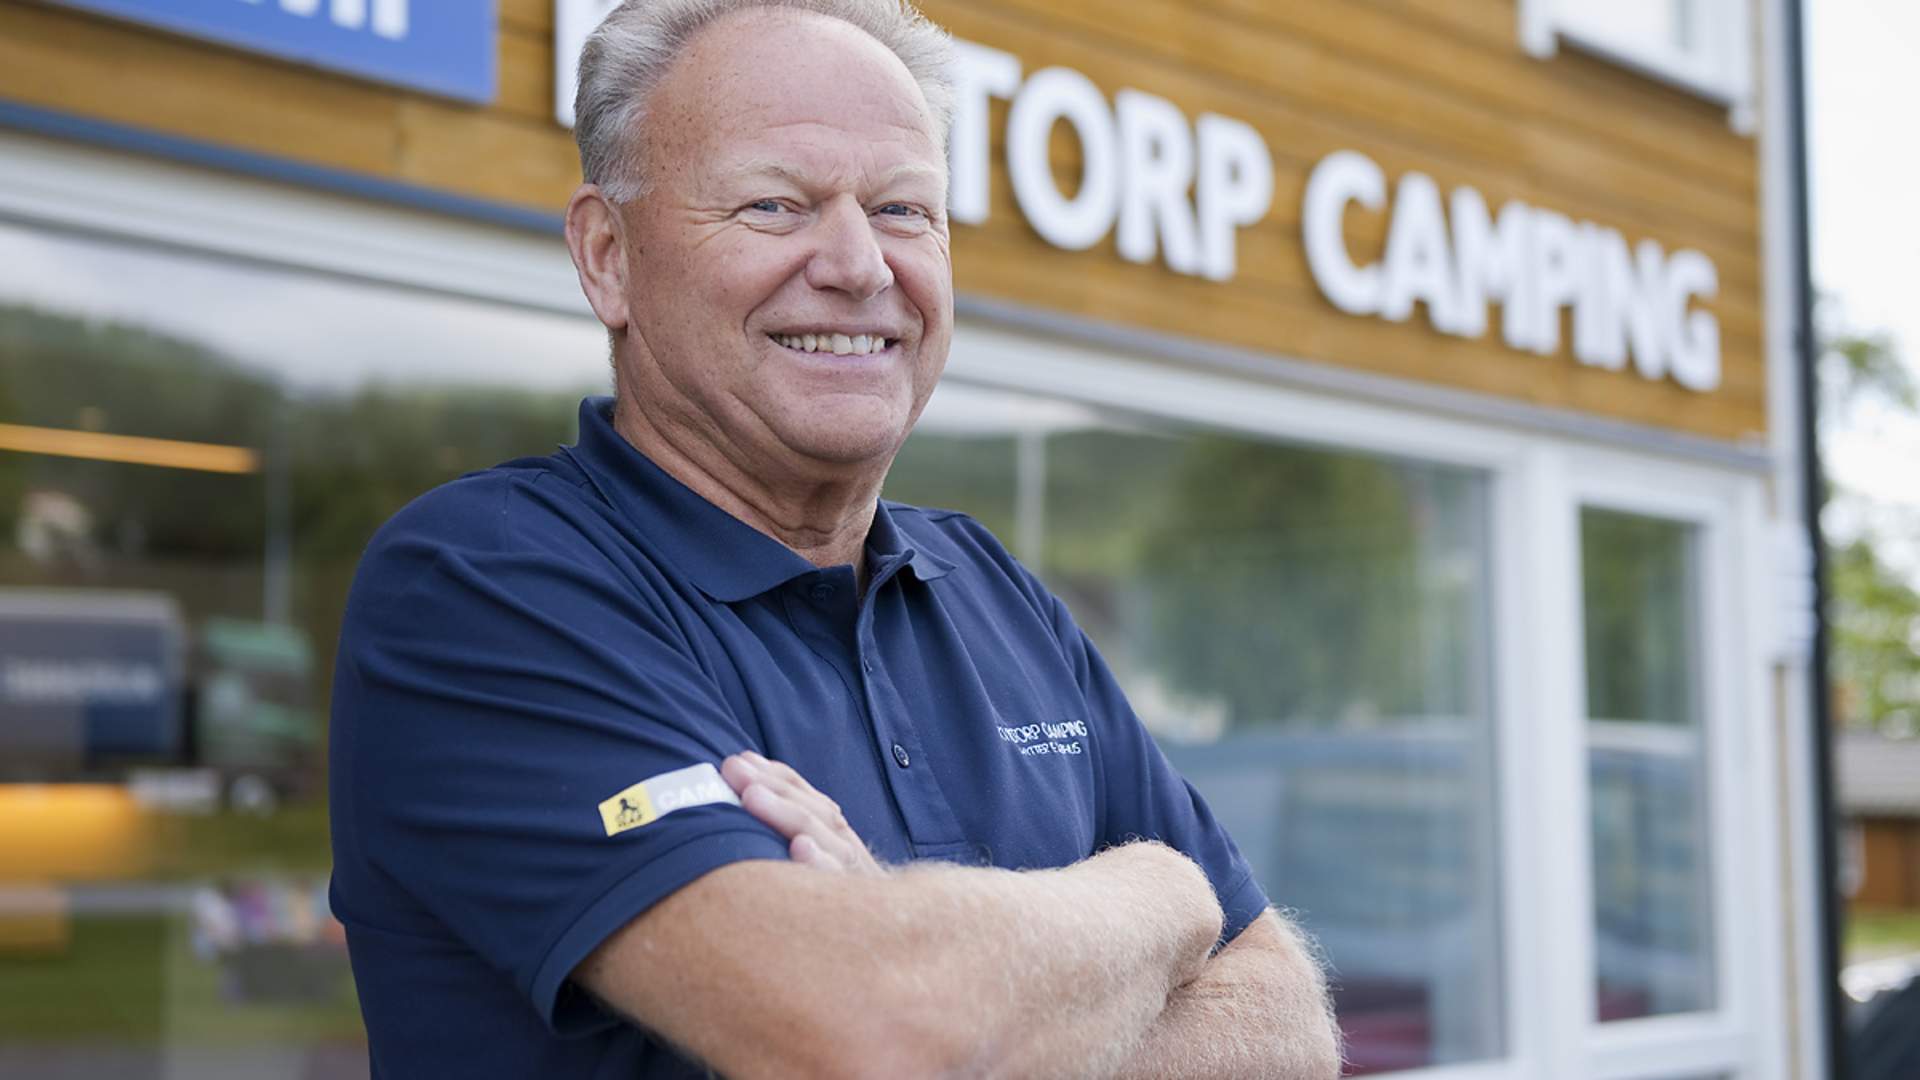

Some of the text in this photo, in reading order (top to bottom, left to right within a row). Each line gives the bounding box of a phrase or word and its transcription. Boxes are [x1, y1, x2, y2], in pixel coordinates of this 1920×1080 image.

[949, 37, 1721, 392] TORP CAMPING
[656, 780, 724, 809] CAM
